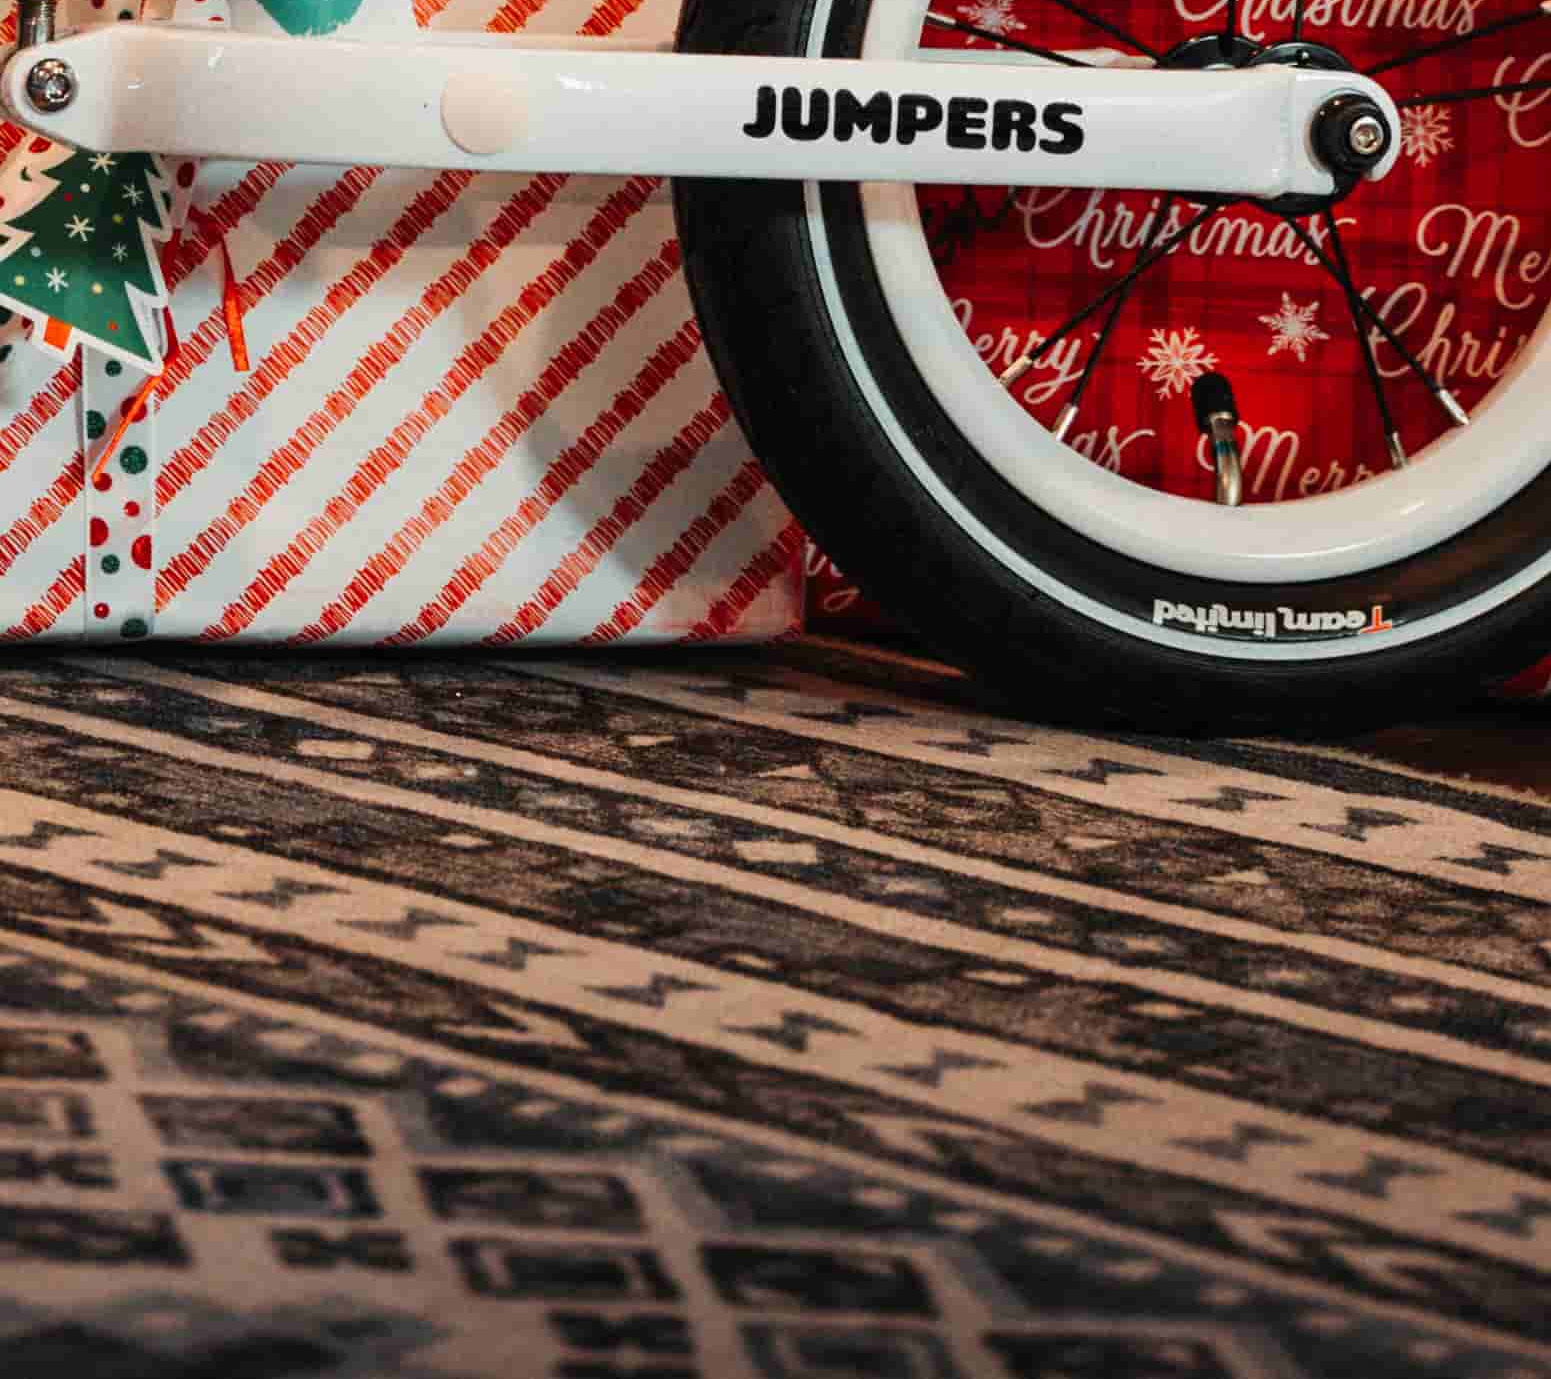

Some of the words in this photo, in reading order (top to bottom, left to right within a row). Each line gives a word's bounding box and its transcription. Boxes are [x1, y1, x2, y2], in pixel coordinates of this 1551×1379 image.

[742, 84, 1086, 155] JUMPERS
[1152, 598, 1277, 638] limited
[1280, 604, 1393, 636] Team
